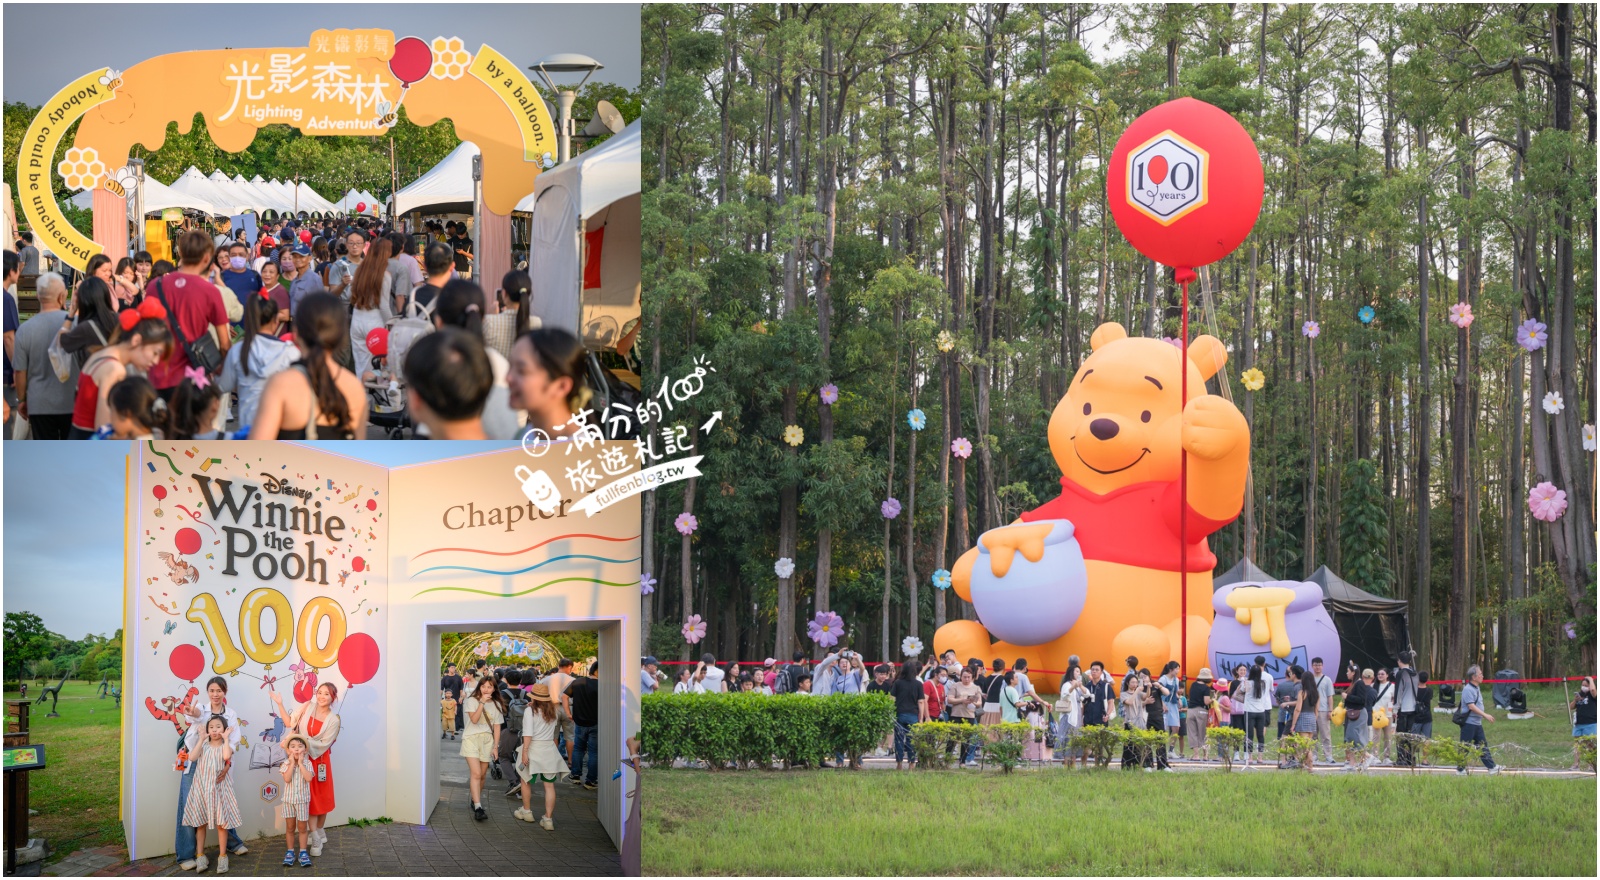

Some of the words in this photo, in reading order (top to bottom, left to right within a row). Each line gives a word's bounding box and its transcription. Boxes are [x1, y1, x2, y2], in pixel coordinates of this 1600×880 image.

[48, 84, 99, 126] Nobody
[218, 53, 390, 122] 光影森林
[244, 103, 303, 121] Lighting
[486, 60, 505, 79] by
[503, 78, 513, 88] a
[512, 87, 544, 147] balloon.
[29, 127, 51, 168] could
[29, 173, 41, 191] be
[1159, 191, 1187, 201] years
[32, 195, 91, 261] uncheered
[191, 473, 346, 542] Winnie
[221, 525, 329, 585] Pooh
[263, 531, 294, 551] the
[186, 587, 347, 675] 100
